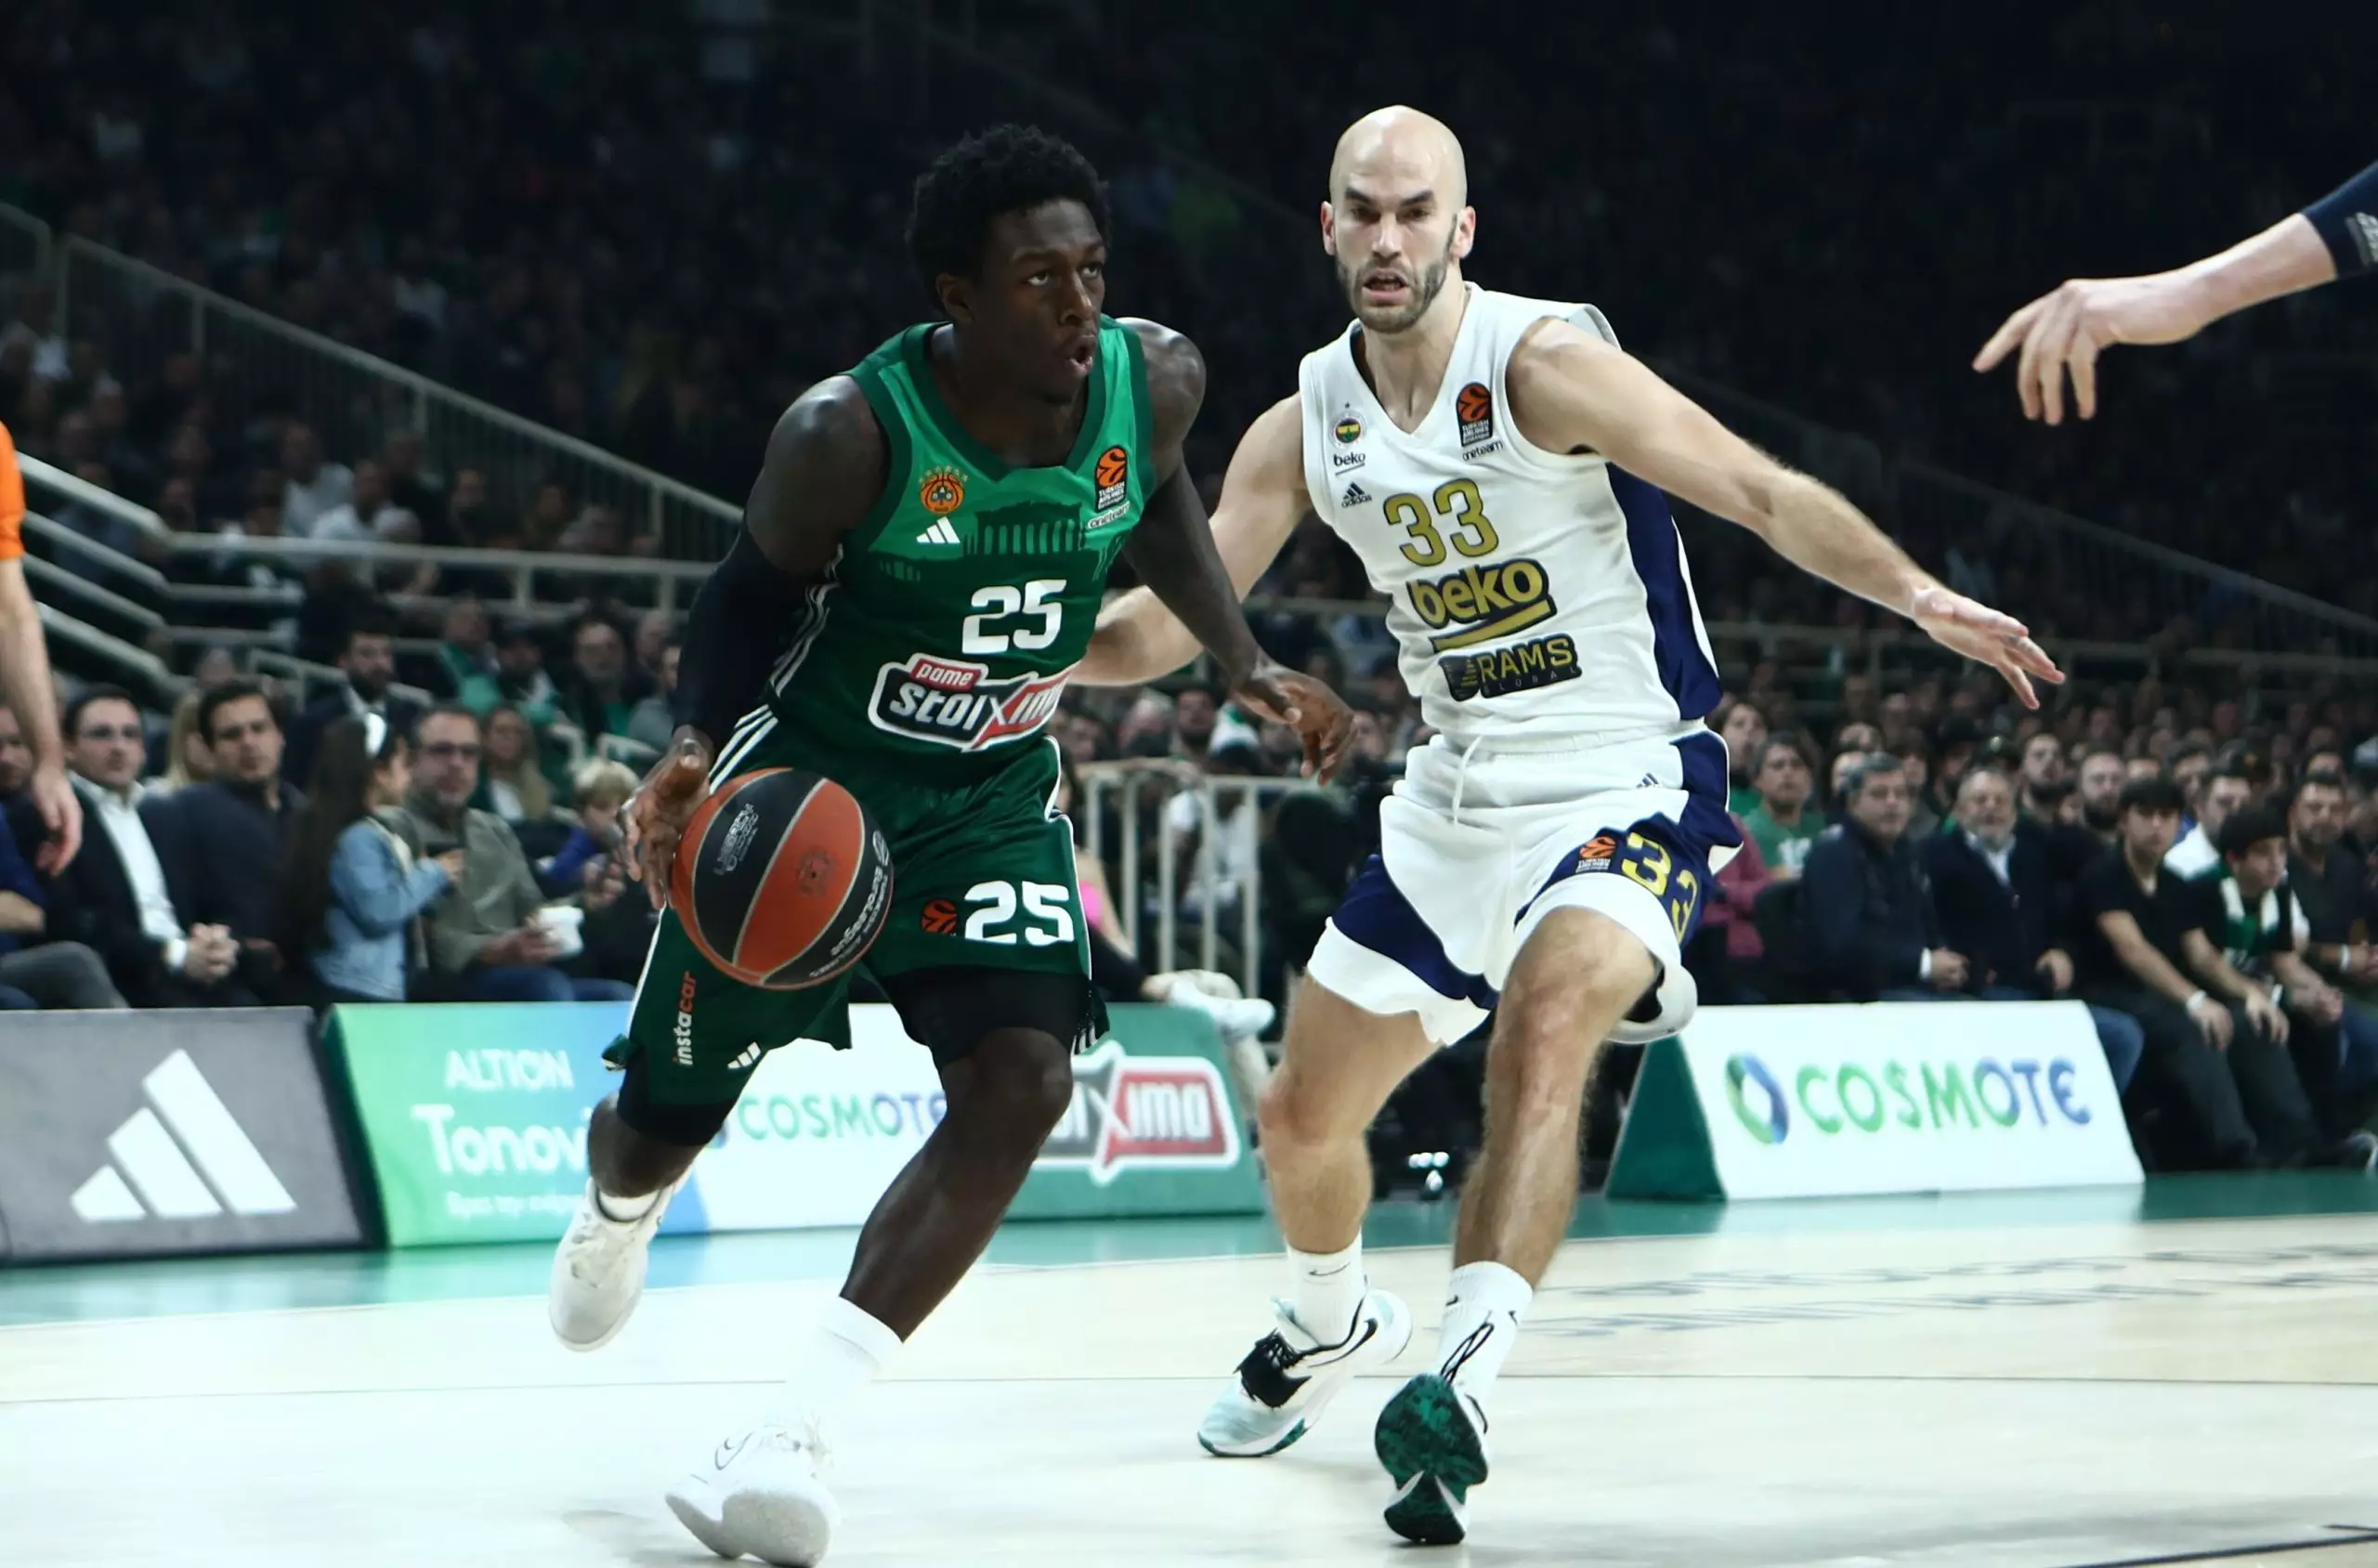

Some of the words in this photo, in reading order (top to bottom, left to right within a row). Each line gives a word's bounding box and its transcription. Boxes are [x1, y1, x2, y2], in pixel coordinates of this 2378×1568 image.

[1333, 451, 1365, 466] beko
[1340, 494, 1372, 508] adidas
[1383, 477, 1499, 567] 33
[962, 580, 1067, 654] 25
[1406, 558, 1549, 630] beko
[915, 662, 974, 686] pame
[1477, 637, 1574, 683] RAMS
[964, 880, 1075, 946] 25
[673, 971, 696, 1065] instacar
[445, 1049, 574, 1091] ALTION
[1795, 1056, 2093, 1134] COSMOTE
[411, 1103, 593, 1174] Tonov
